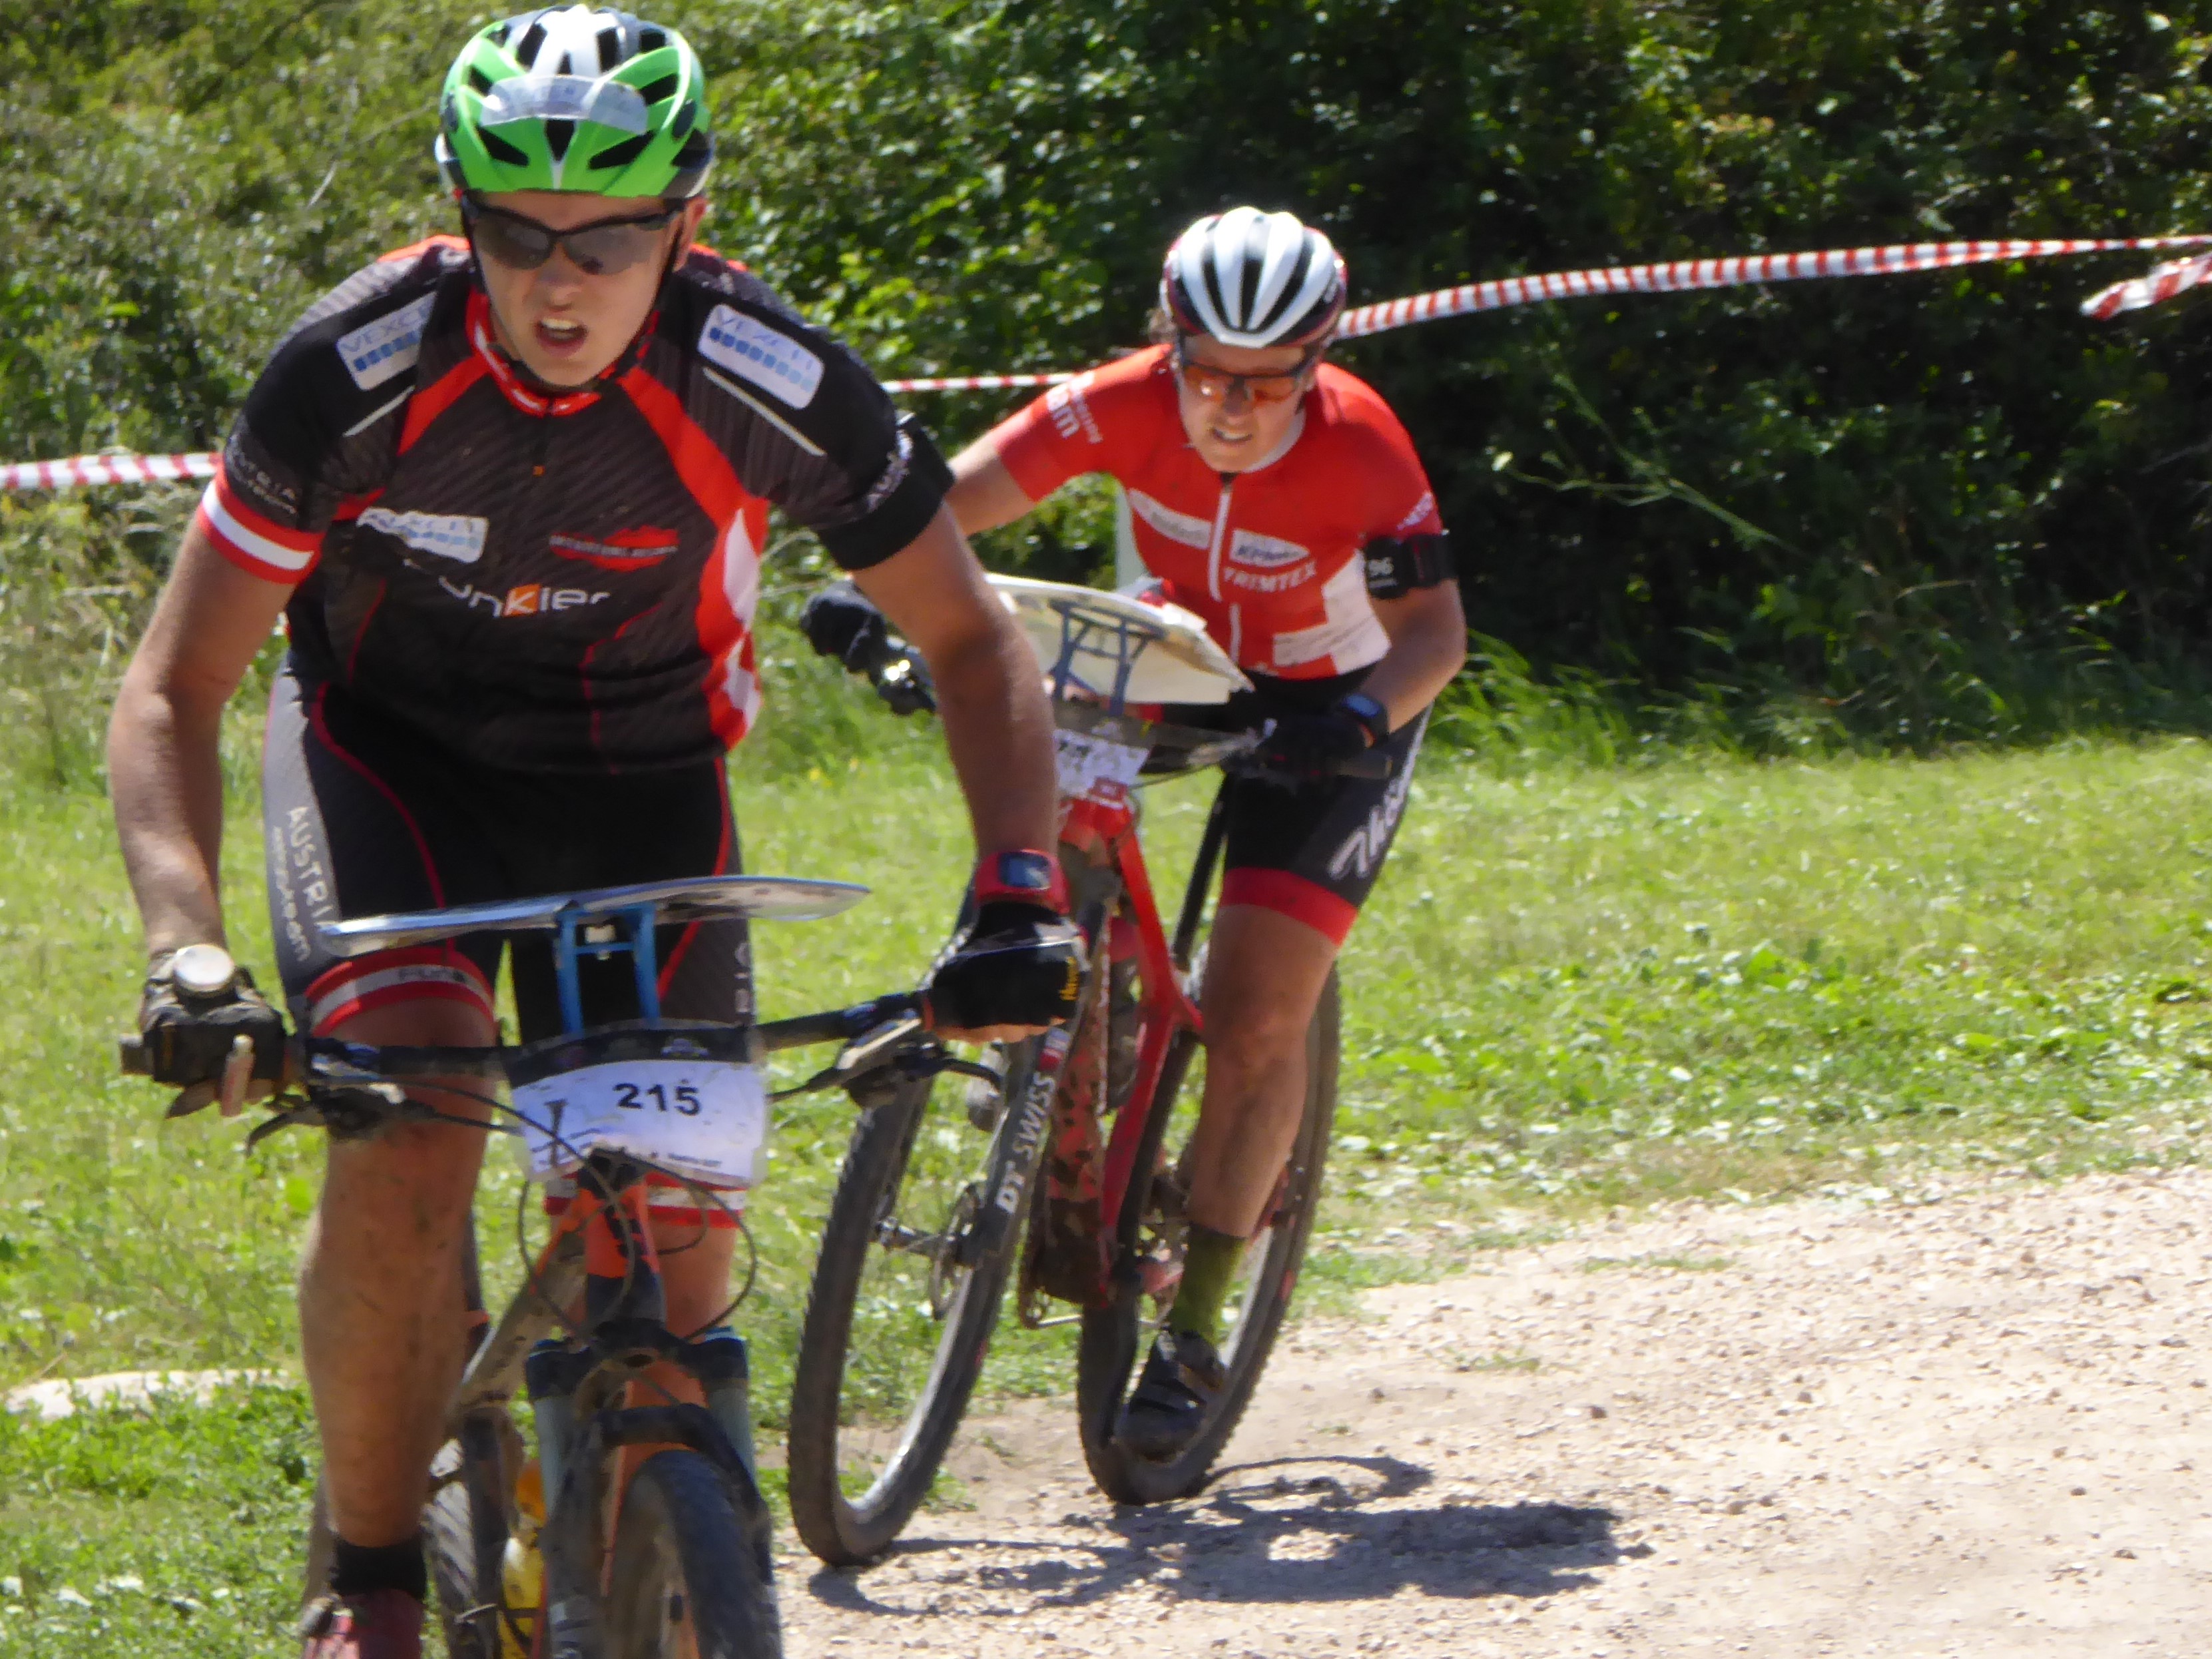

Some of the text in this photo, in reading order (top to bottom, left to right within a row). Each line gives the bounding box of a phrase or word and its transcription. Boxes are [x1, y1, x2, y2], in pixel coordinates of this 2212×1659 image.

[286, 807, 333, 918] AUSTRI
[613, 1082, 702, 1116] 215
[995, 1072, 1056, 1214] DT SWISS
